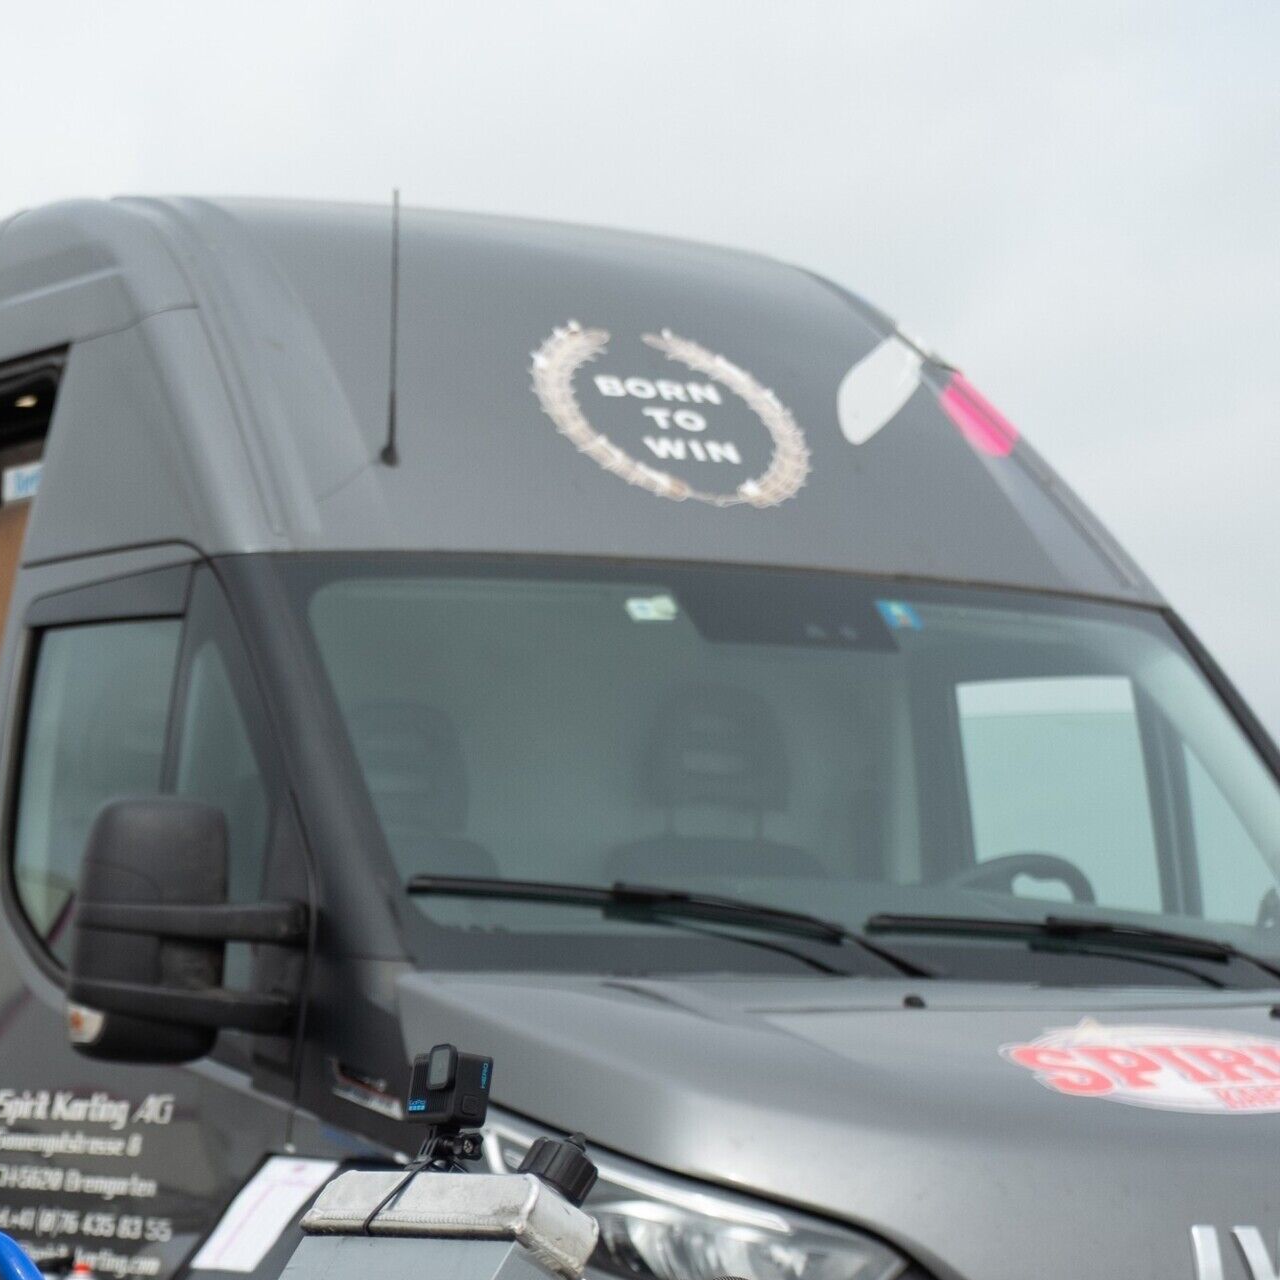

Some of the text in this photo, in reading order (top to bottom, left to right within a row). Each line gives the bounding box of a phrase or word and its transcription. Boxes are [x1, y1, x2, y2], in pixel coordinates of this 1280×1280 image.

[593, 374, 722, 405] BORN
[642, 406, 707, 432] TO
[643, 436, 742, 465] WIN
[52, 1089, 130, 1131] Karting
[131, 1092, 176, 1125] AG
